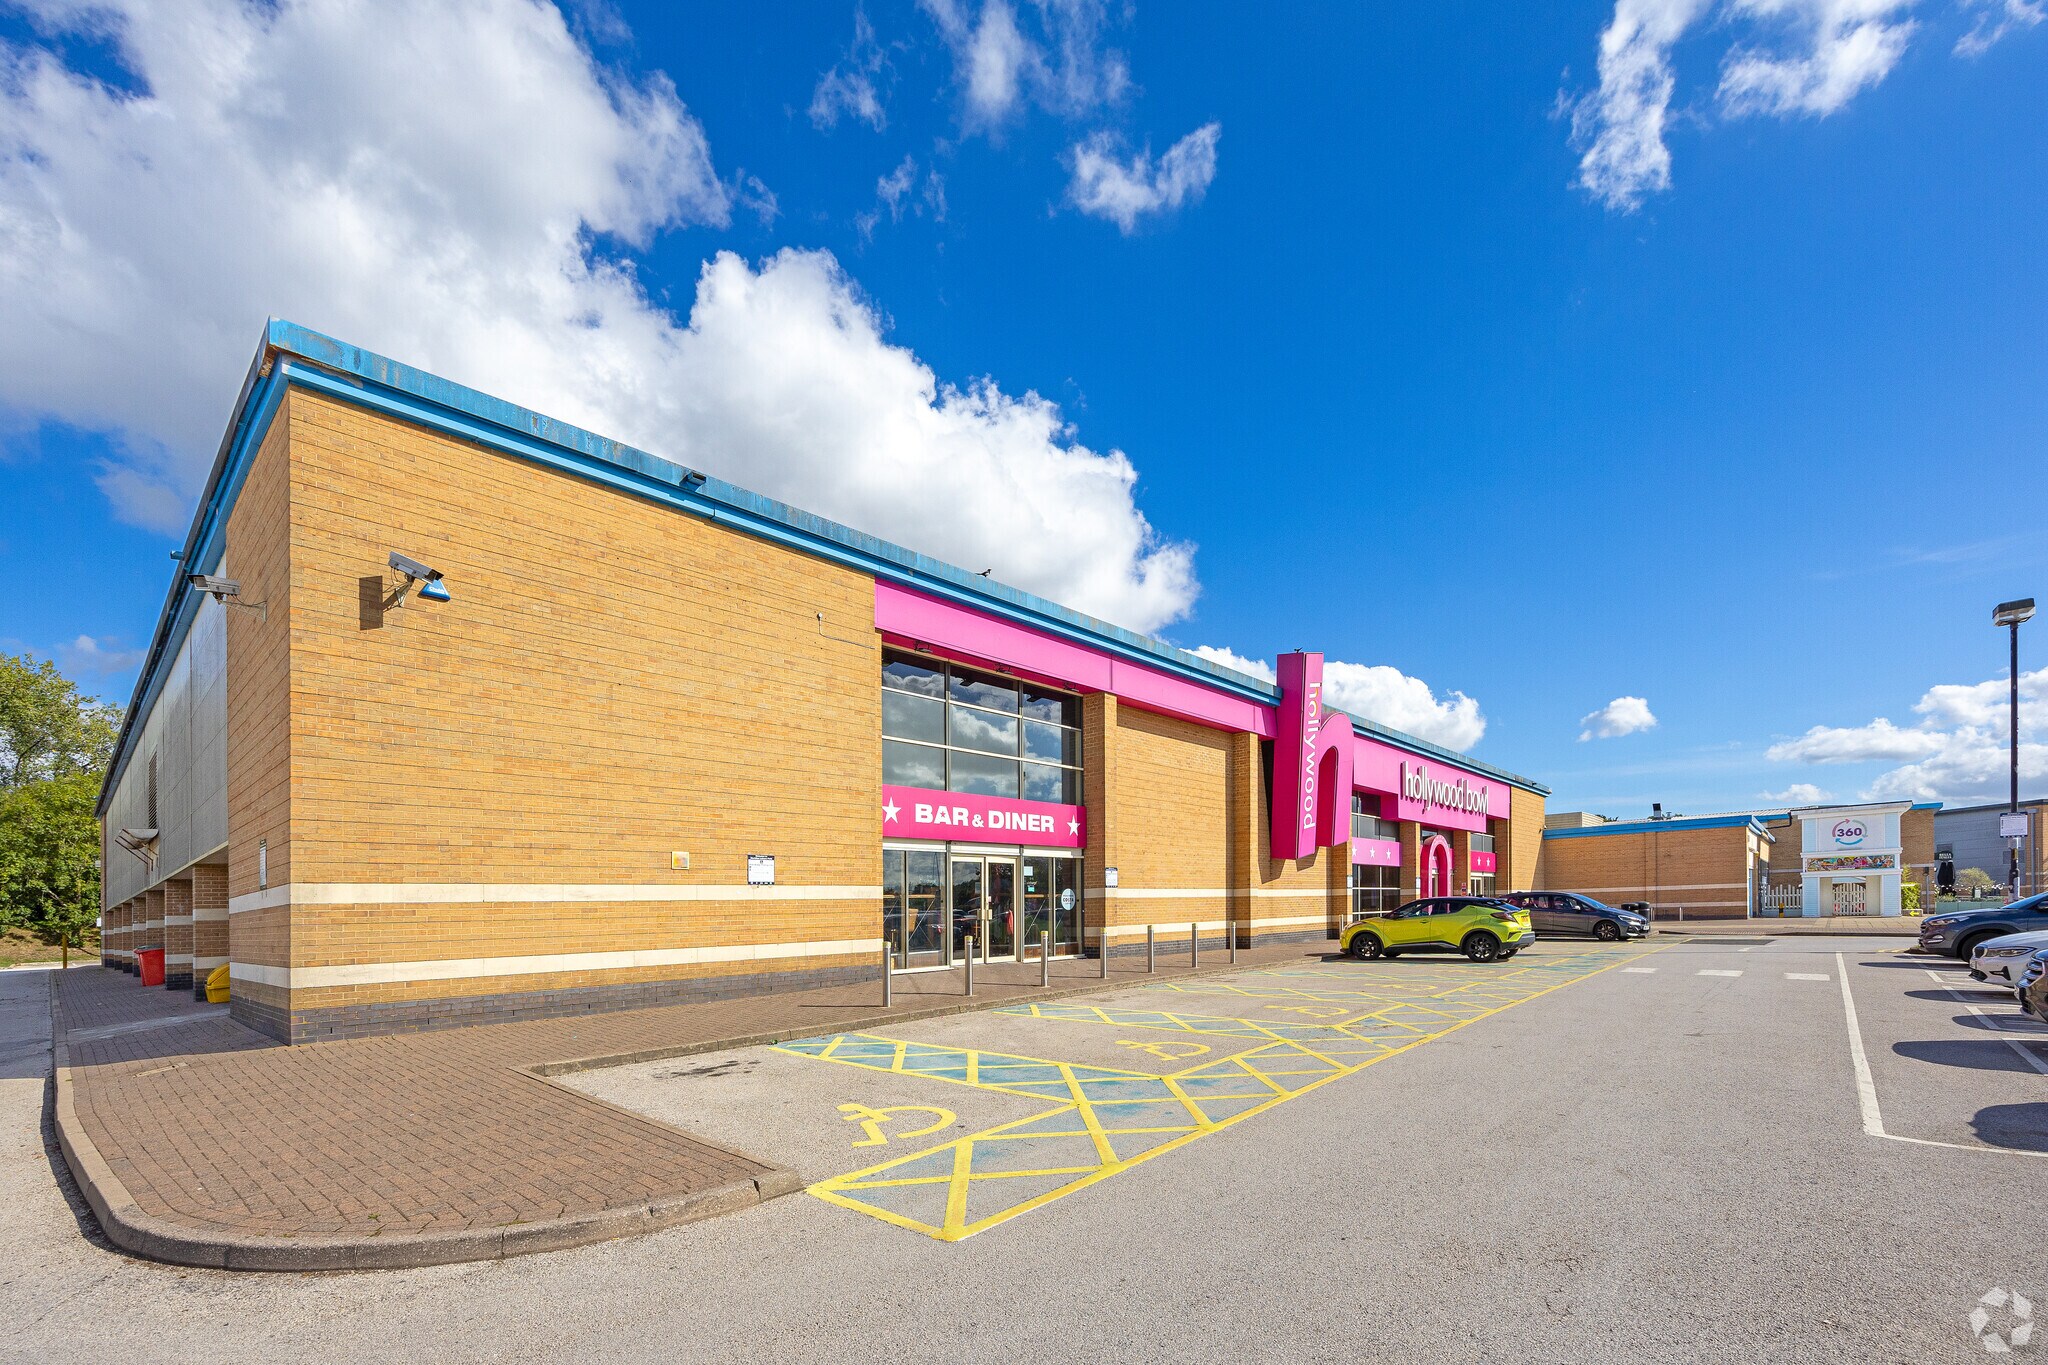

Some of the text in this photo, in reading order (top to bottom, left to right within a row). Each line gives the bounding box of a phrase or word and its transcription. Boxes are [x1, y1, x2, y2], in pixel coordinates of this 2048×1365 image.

[1303, 682, 1322, 829] hollywood
[1404, 761, 1489, 815] hollywood bowl
[915, 803, 1055, 832] BAR & DINER
[1837, 827, 1862, 837] 360
